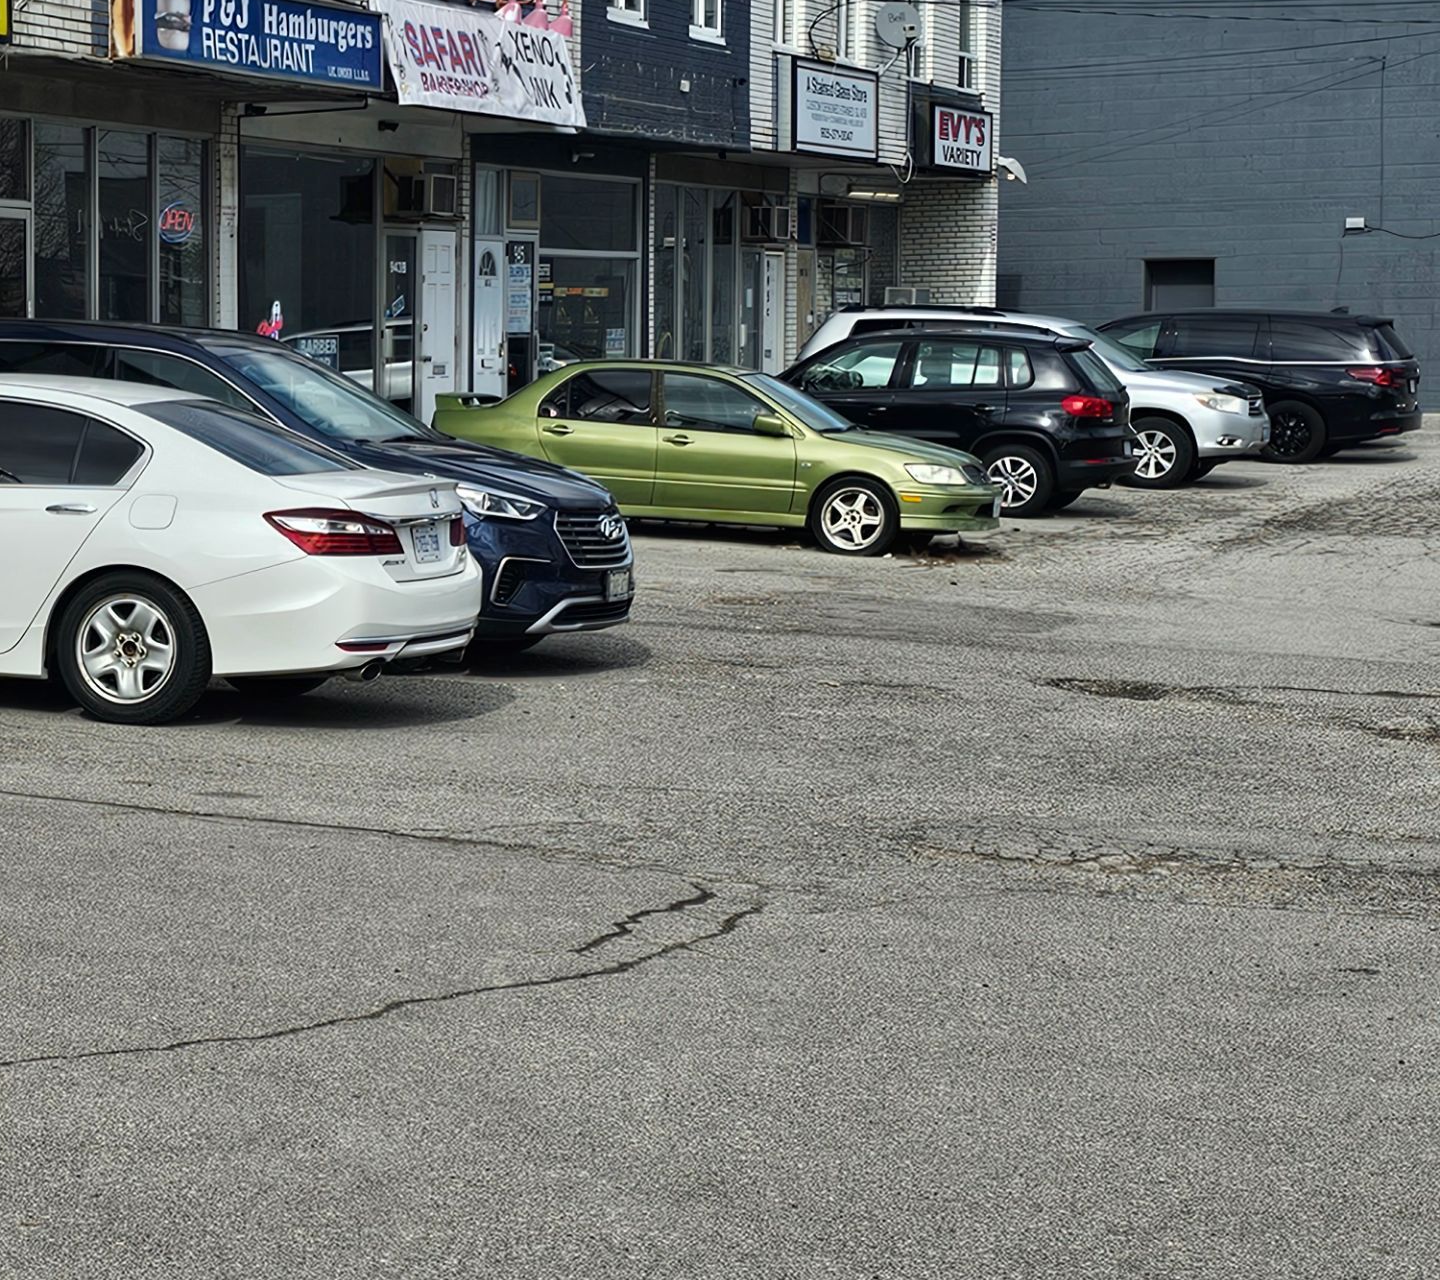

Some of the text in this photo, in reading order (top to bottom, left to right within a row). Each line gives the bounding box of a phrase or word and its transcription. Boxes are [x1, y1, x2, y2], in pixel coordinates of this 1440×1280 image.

[263, 2, 373, 53] Hamburgers
[201, 26, 316, 74] RESTAURANT
[403, 19, 488, 79] SAFARI
[508, 29, 555, 68] XENO
[938, 109, 986, 147] EVY'S
[942, 144, 982, 168] VARIETY
[161, 209, 195, 232] OPEN
